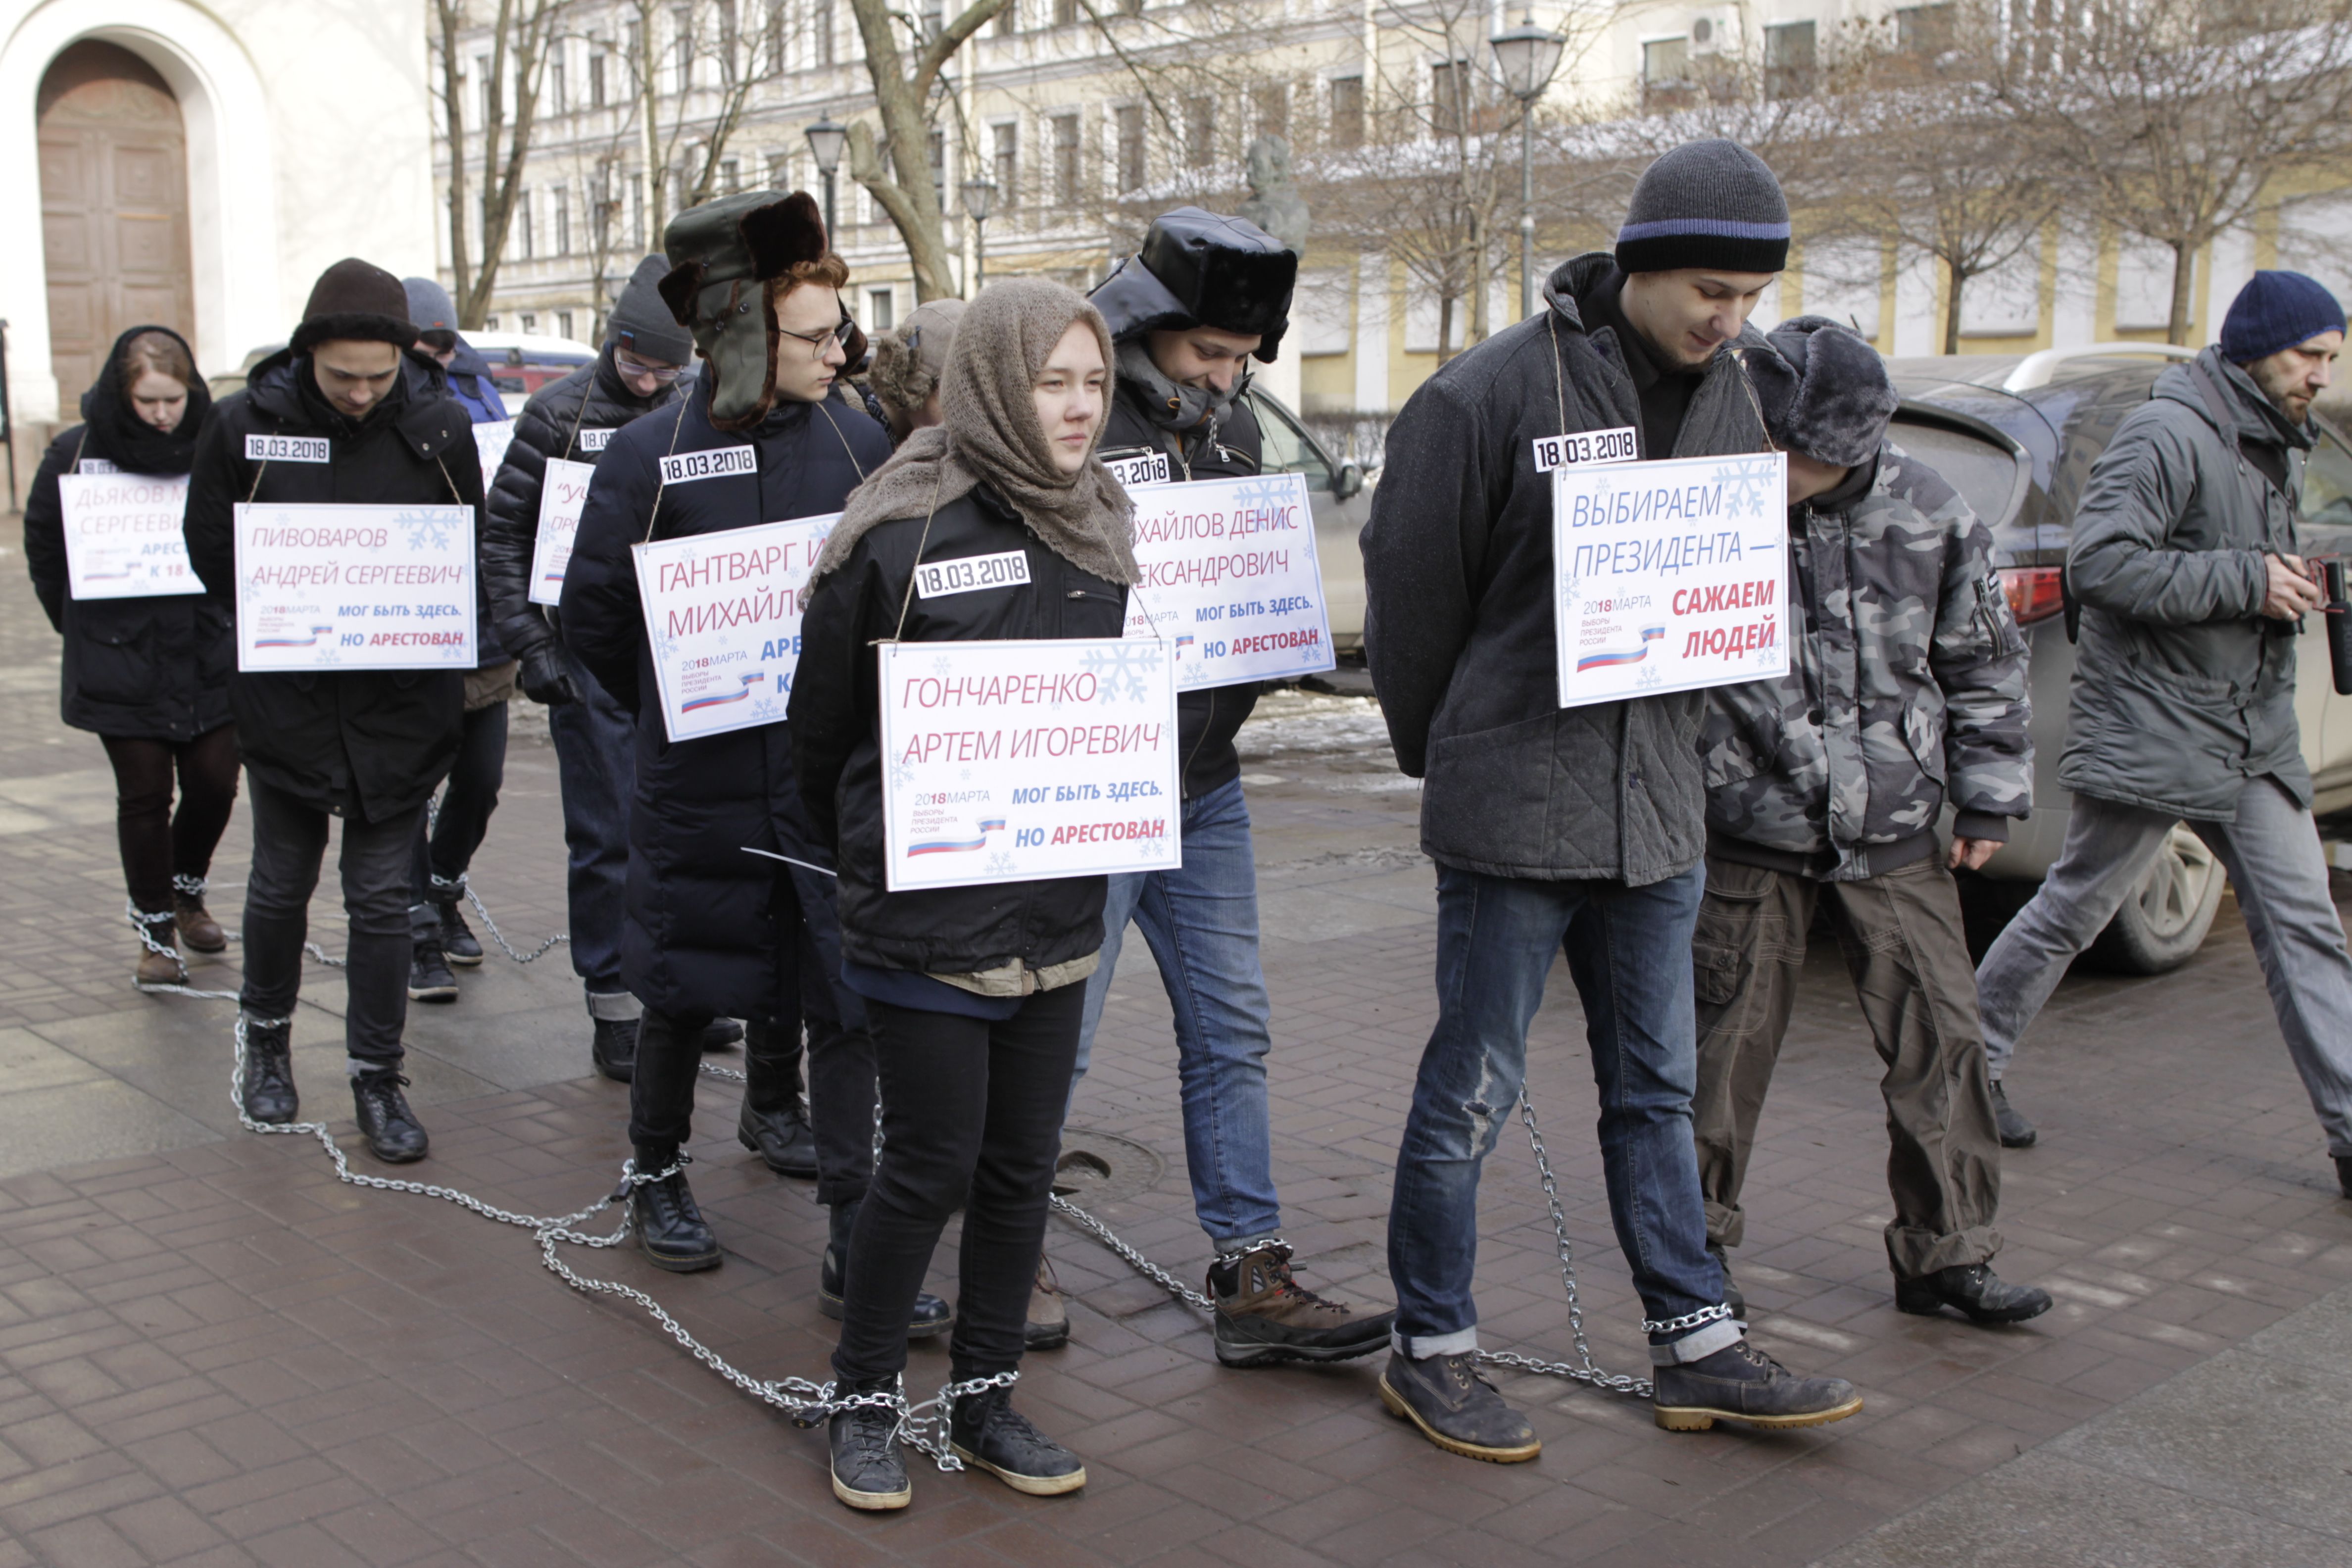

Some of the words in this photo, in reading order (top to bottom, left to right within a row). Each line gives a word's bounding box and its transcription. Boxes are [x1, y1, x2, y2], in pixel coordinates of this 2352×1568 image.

[249, 439, 327, 459] 18.03.2018
[583, 432, 612, 447] 18.0
[1537, 432, 1633, 467] 1803.2018
[663, 449, 754, 481] 18.03.2018
[1109, 457, 1167, 486] 3.2018
[76, 485, 165, 510] ДЬЯКОВ
[1571, 484, 1722, 528] ВЫБИРАЕМ
[1132, 510, 1225, 545] ХАЙЛОВ
[1228, 505, 1298, 541] ДЕНИС
[251, 528, 388, 547] ПИВОВАРОВ
[1573, 531, 1742, 578] ПРЕЗИДЕНТА
[150, 565, 160, 578] К
[166, 564, 183, 576] 18
[251, 561, 340, 588] АНДРЕЙ
[344, 564, 461, 585] СЕРГЕЕВИЧ
[659, 542, 797, 593] ГАНТВАРГ
[919, 555, 1027, 594] 18.03.2018
[1583, 595, 1652, 615] 2018МАРТА
[1672, 579, 1776, 616] САЖАЕМ
[338, 605, 369, 617] МОГ
[373, 605, 410, 617] БЫТЬ
[415, 604, 462, 619] ЗДЕСЬ.
[1196, 605, 1225, 623] МОГ
[1229, 600, 1265, 619] БЫТЬ
[1269, 595, 1314, 617] ЗДЕСЬ.
[1580, 625, 1622, 637] ПРЕЗИДЕНТА
[1581, 617, 1611, 627] ВЫБОРЫ
[340, 633, 365, 646] НО
[369, 632, 464, 646] АРЕСТОВАН
[1204, 640, 1226, 659] НО
[1231, 628, 1319, 656] АРЕСТОВАН
[1579, 637, 1607, 645] РОССИИ
[1682, 613, 1776, 661] ЛЮДЕЙ
[682, 650, 748, 672] 2018МАРТА
[681, 670, 709, 681] ВЫБОРЫ
[681, 675, 722, 687] ПРЕЗИДЕНТА
[777, 672, 791, 693] К
[681, 685, 707, 694] РОССИИ
[903, 672, 1097, 709] ГОНЧАРЕНКО
[901, 730, 1002, 765] АРТЕМ
[1010, 723, 1161, 760] ИГОРЕВИЧ
[914, 790, 990, 806] 2018МАРТА
[1012, 786, 1051, 805] МОГ
[1055, 784, 1101, 802] БЫТЬ
[1106, 780, 1163, 802] ЗДЕСЬ.
[911, 816, 958, 826] ПРЕЗИДЕНТА
[912, 808, 944, 817] ВЫБОРЫ
[910, 826, 940, 834] РОССИИ
[1015, 827, 1045, 848] НО
[1050, 819, 1166, 845] АРЕСТОВАН
